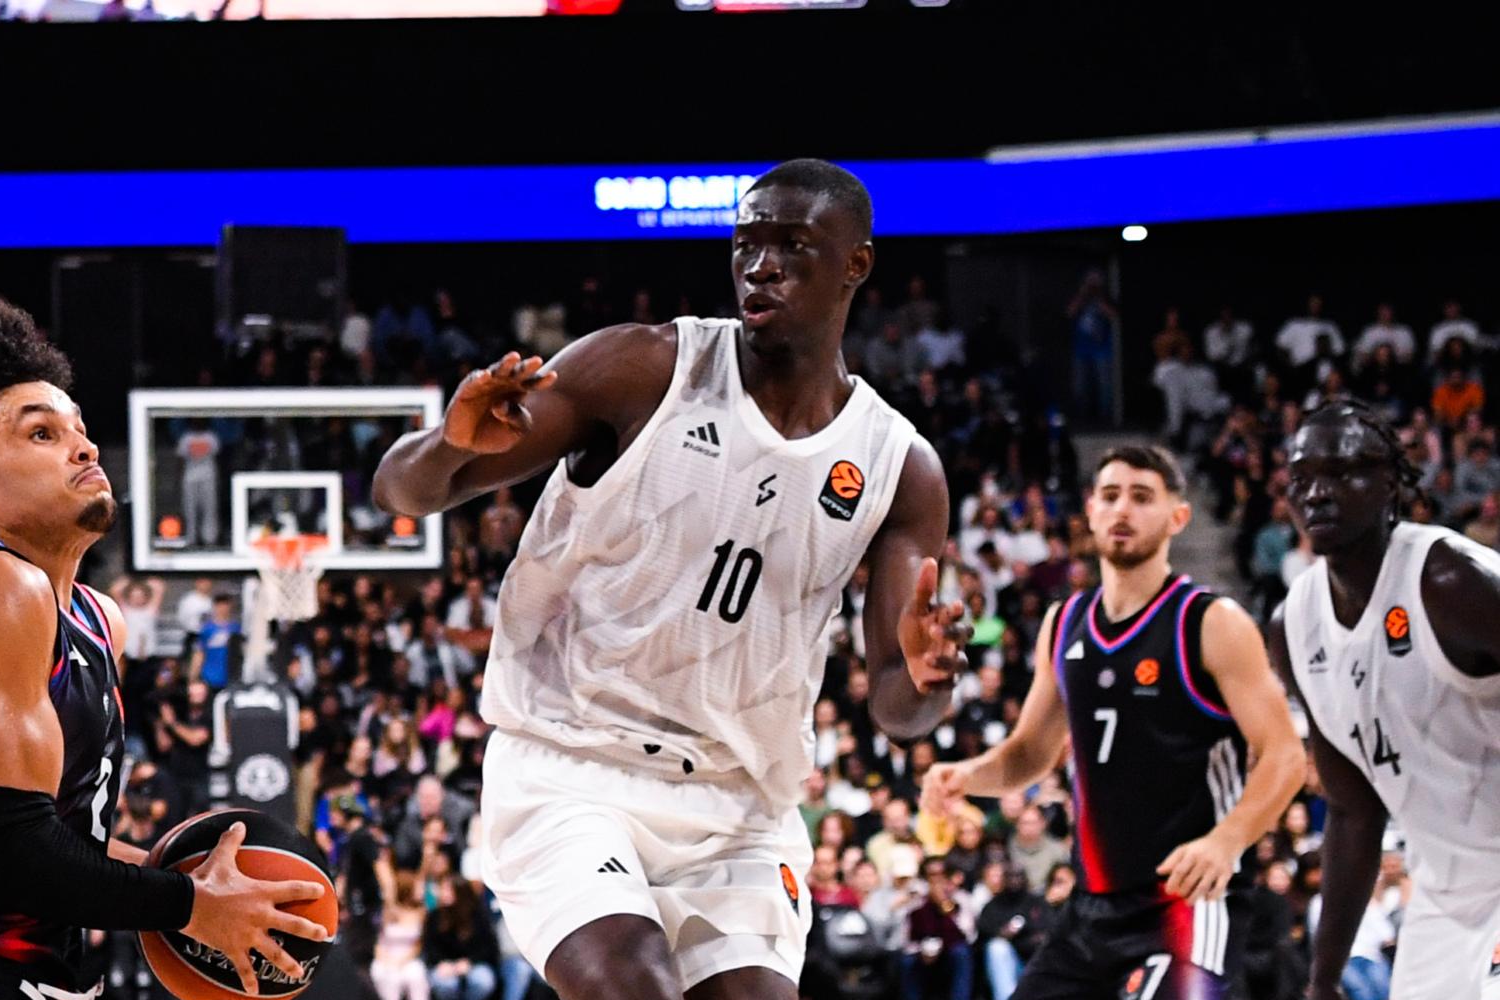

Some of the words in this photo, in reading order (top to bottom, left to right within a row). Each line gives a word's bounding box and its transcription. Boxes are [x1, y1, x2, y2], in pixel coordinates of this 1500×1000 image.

[696, 539, 763, 624] 10
[1094, 708, 1118, 764] 7
[1350, 718, 1402, 784] 14
